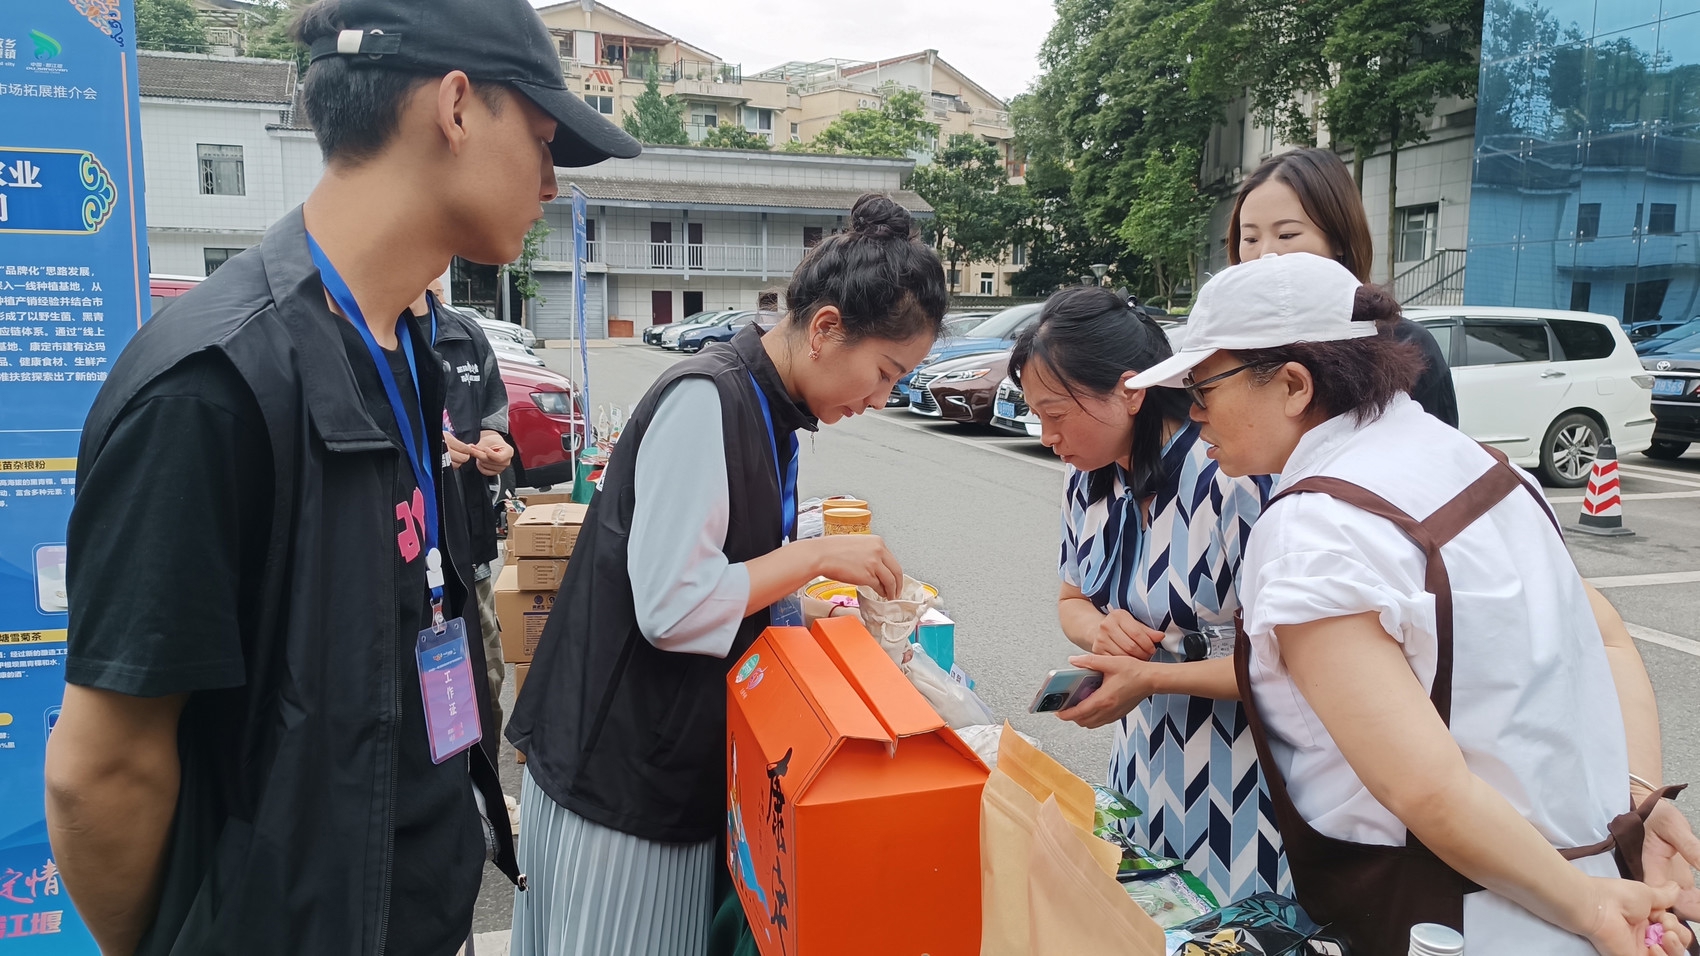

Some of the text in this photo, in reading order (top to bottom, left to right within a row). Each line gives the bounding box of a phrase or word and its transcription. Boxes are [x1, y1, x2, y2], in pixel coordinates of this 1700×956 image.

[0, 160, 43, 188] 业
[0, 281, 103, 292] 入一线种植基地，从
[0, 460, 46, 470] 苗杂粮粉
[444, 670, 457, 716] 工作证
